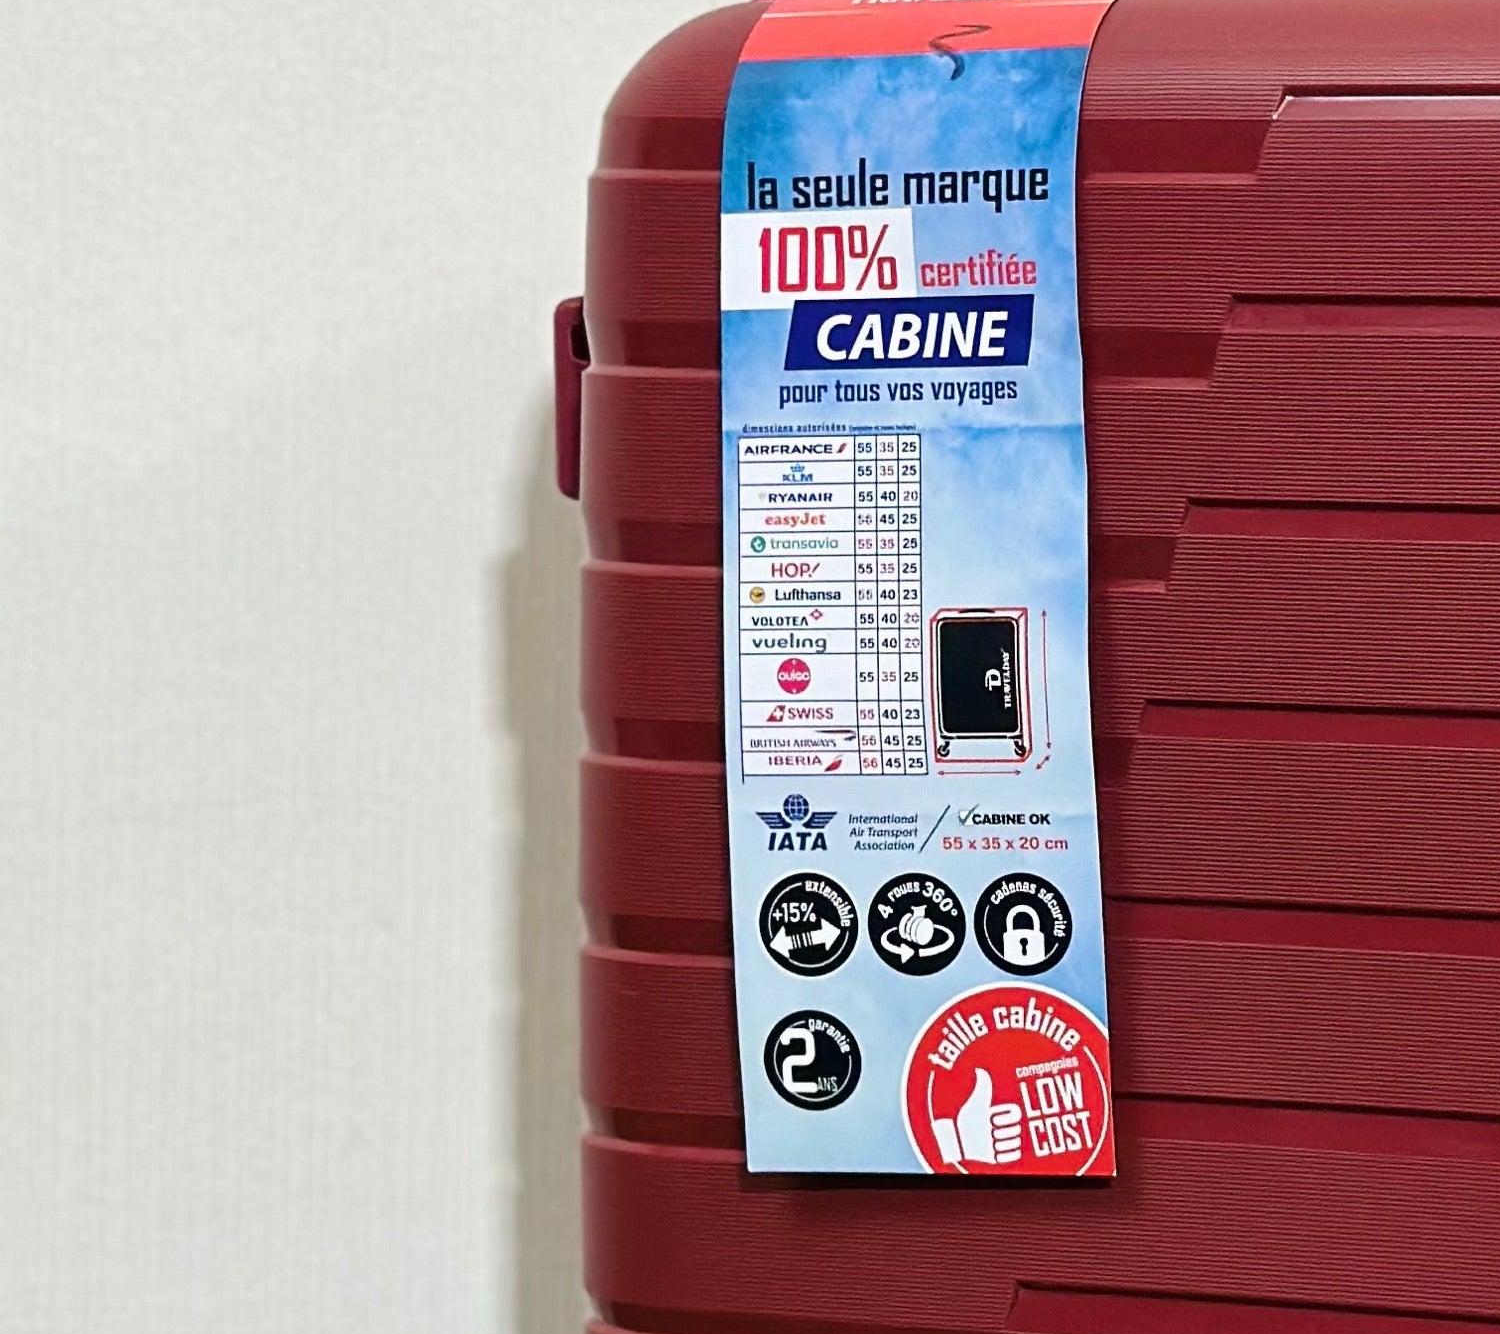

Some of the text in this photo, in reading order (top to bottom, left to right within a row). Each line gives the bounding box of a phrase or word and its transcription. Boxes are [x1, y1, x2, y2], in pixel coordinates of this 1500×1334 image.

[747, 158, 1049, 213] la seule marque
[758, 224, 1037, 294] 100% certifiée
[816, 310, 1009, 361] CABINE
[779, 380, 1018, 409] pour tous vos voyages
[857, 442, 872, 453] 55
[879, 442, 894, 453] 35
[901, 442, 917, 453] 25
[782, 465, 917, 482] KLM 55 35 25
[768, 491, 918, 503] RYANAIR 55 40 20
[765, 513, 826, 527] easyJet
[879, 514, 895, 525] 45
[902, 514, 917, 525] 25
[770, 537, 839, 549] transavia
[858, 538, 873, 549] 55
[902, 538, 917, 549] 25
[771, 562, 917, 578] HOP! 55 35 25
[775, 589, 841, 601] Lufthansa
[880, 590, 896, 600] 40
[902, 590, 918, 600] 23
[752, 616, 809, 627] VOLOTEA
[859, 613, 875, 624] 55
[881, 613, 897, 624] 40
[752, 633, 827, 653] vueling
[859, 638, 875, 649] 55
[881, 638, 897, 649] 40
[859, 671, 875, 683] 55
[881, 671, 897, 683] 35
[903, 671, 919, 683] 25
[788, 707, 834, 720] SWISS
[882, 709, 898, 720] 40
[904, 709, 921, 720] 23
[794, 738, 837, 748] AIRWAYS
[884, 735, 900, 746] 45
[906, 735, 922, 746] 25
[768, 755, 822, 766] IBERIA
[885, 757, 901, 768] 45
[908, 757, 924, 768] 25
[848, 814, 918, 824] International
[972, 814, 1050, 825] CABINE OK
[849, 826, 918, 839] Air Transport
[768, 832, 828, 851] IATA
[854, 841, 915, 851] Association
[942, 836, 1068, 850] 55 x 35 x 20 cm
[877, 881, 958, 919] 4 roues 360°
[990, 881, 1037, 905] cadenas
[805, 880, 854, 927] extensible
[772, 902, 817, 923] +15%
[808, 1018, 850, 1054] garantie
[928, 997, 1081, 1070] taille cabine
[780, 1027, 838, 1093] 2 ANS
[1019, 1071, 1084, 1118] LOW
[1028, 1110, 1093, 1158] COST
